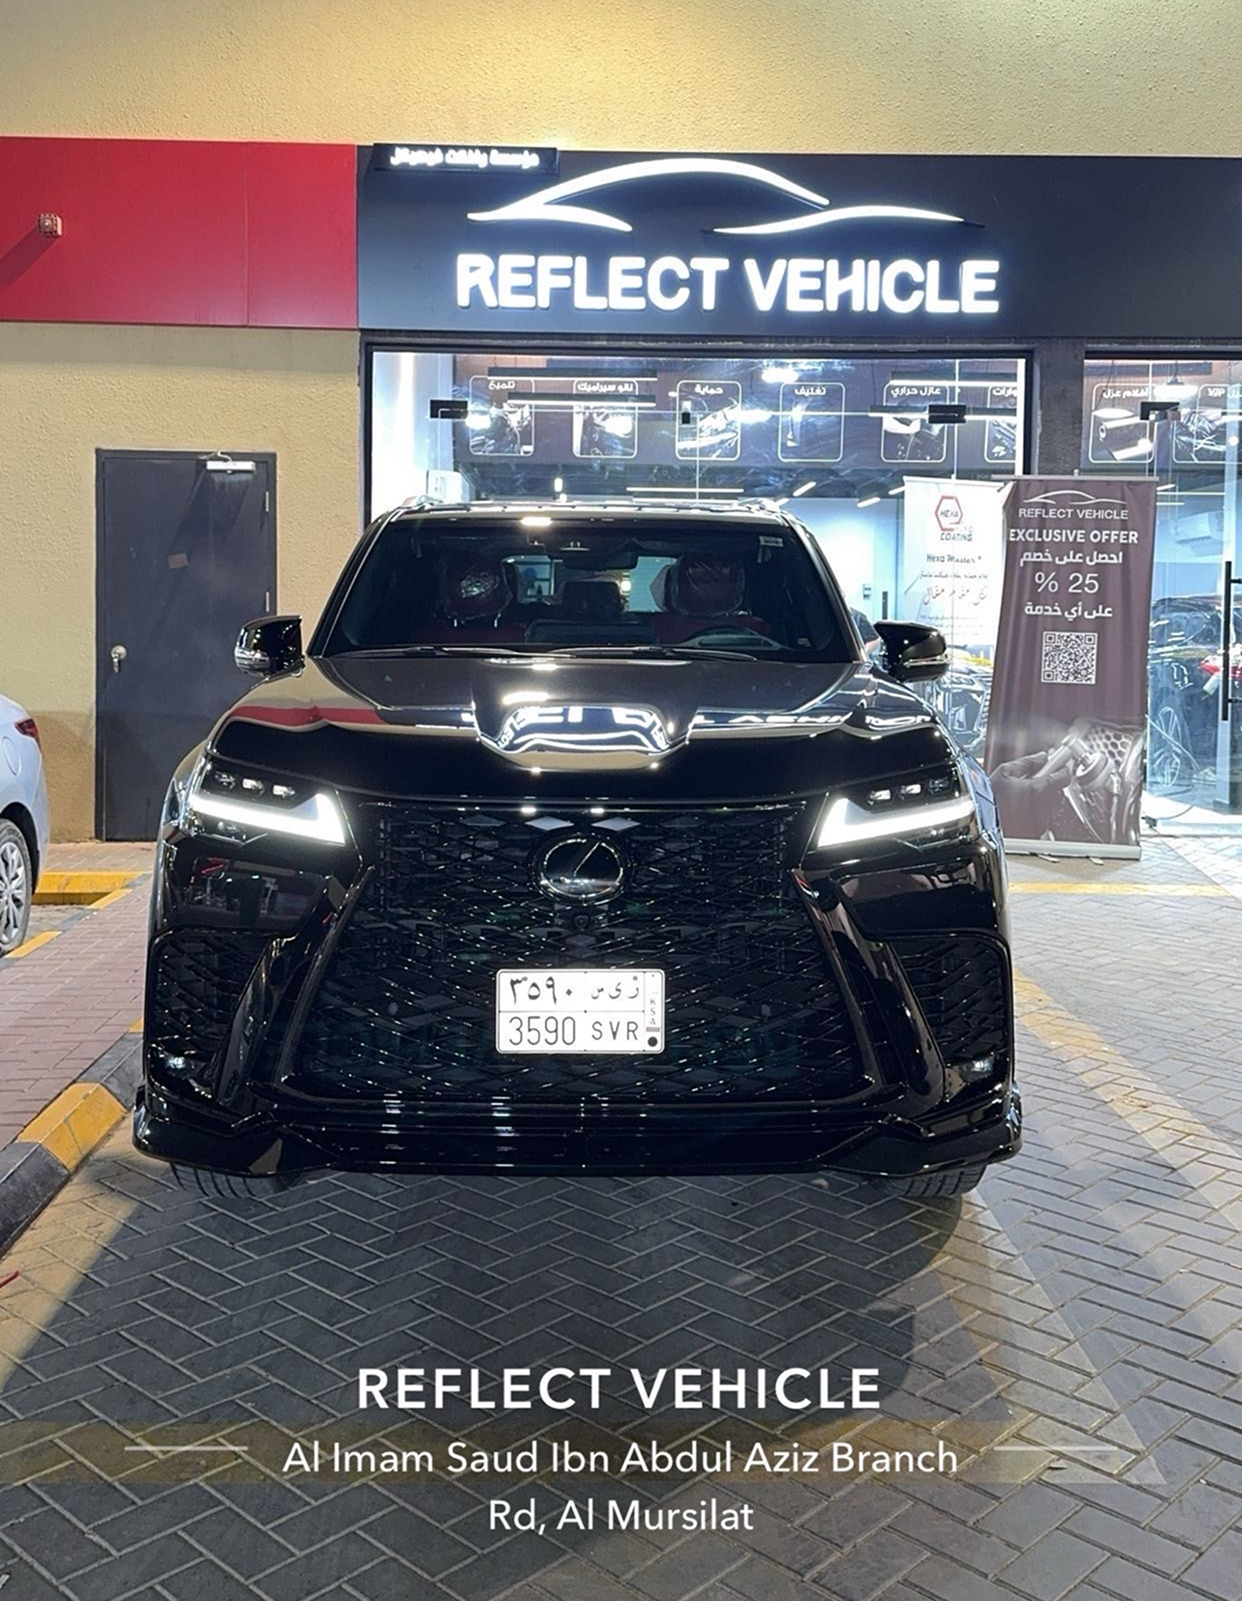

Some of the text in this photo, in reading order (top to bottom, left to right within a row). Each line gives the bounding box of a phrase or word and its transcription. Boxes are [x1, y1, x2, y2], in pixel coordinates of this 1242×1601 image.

[456, 253, 1000, 314] REFLECT VEHICLE
[694, 383, 724, 395] حماية
[794, 386, 827, 396] تغليف
[890, 386, 942, 397] عازل حراري
[1018, 508, 1129, 520] REFLECT VEHICLE
[1009, 528, 1139, 544] EXCLUSIVE OFFER
[1019, 548, 1123, 567] احصل على خصم
[1034, 571, 1099, 594] % 25
[1024, 601, 1113, 621] على أي خدمة
[509, 1016, 576, 1046] 3590
